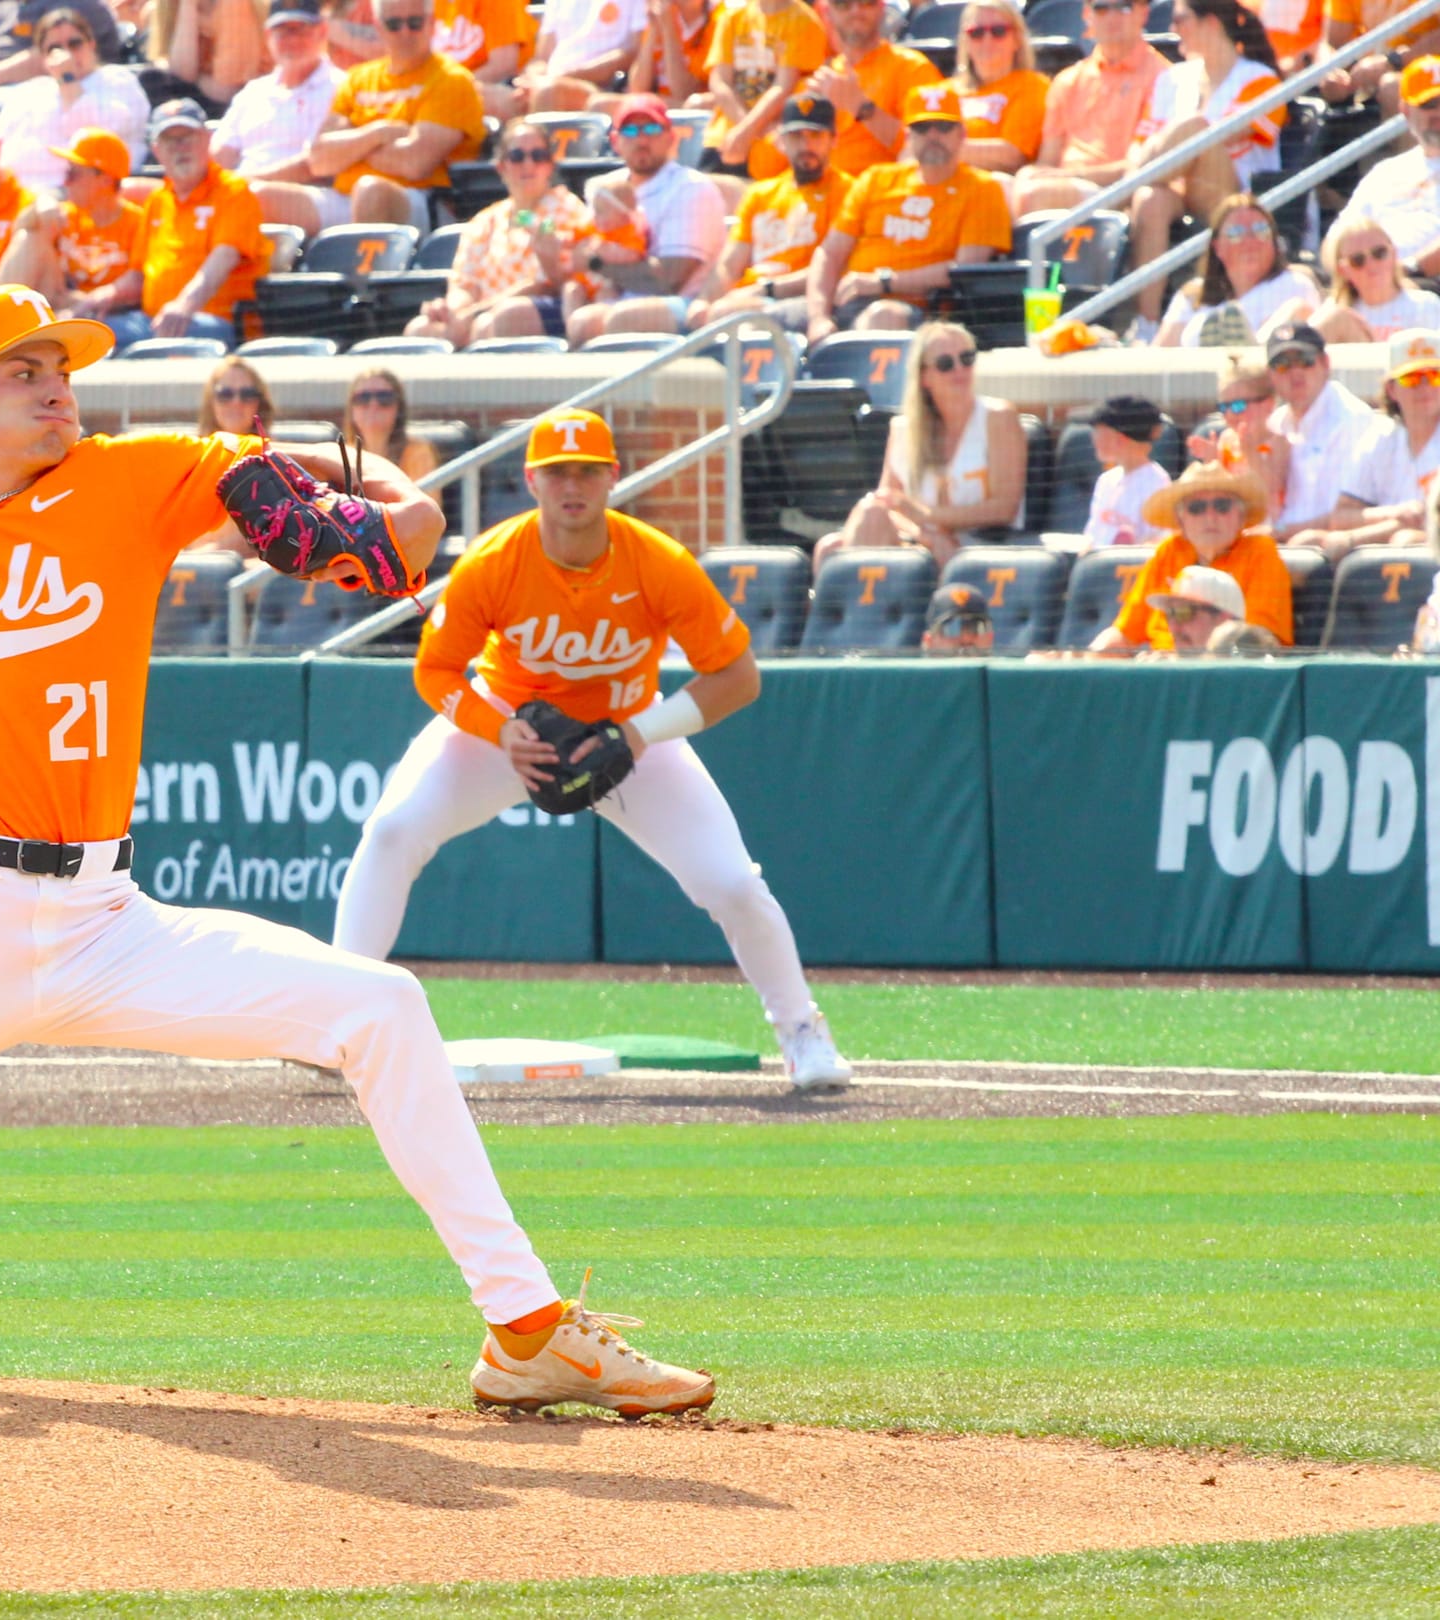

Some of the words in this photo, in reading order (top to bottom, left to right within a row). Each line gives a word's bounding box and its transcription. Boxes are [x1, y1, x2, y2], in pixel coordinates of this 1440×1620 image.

[920, 89, 947, 111] T
[8, 288, 52, 328] T
[553, 419, 588, 452] T
[168, 569, 195, 607] T
[729, 565, 758, 604] T
[857, 566, 888, 606] T
[987, 568, 1017, 607] T
[1381, 562, 1410, 603] T
[503, 613, 653, 668] Vols
[608, 673, 647, 711] 16
[45, 679, 109, 763] 21
[130, 760, 221, 824] ern
[1155, 734, 1418, 877] FOOD
[153, 839, 204, 900] of
[205, 843, 356, 901] Americ
